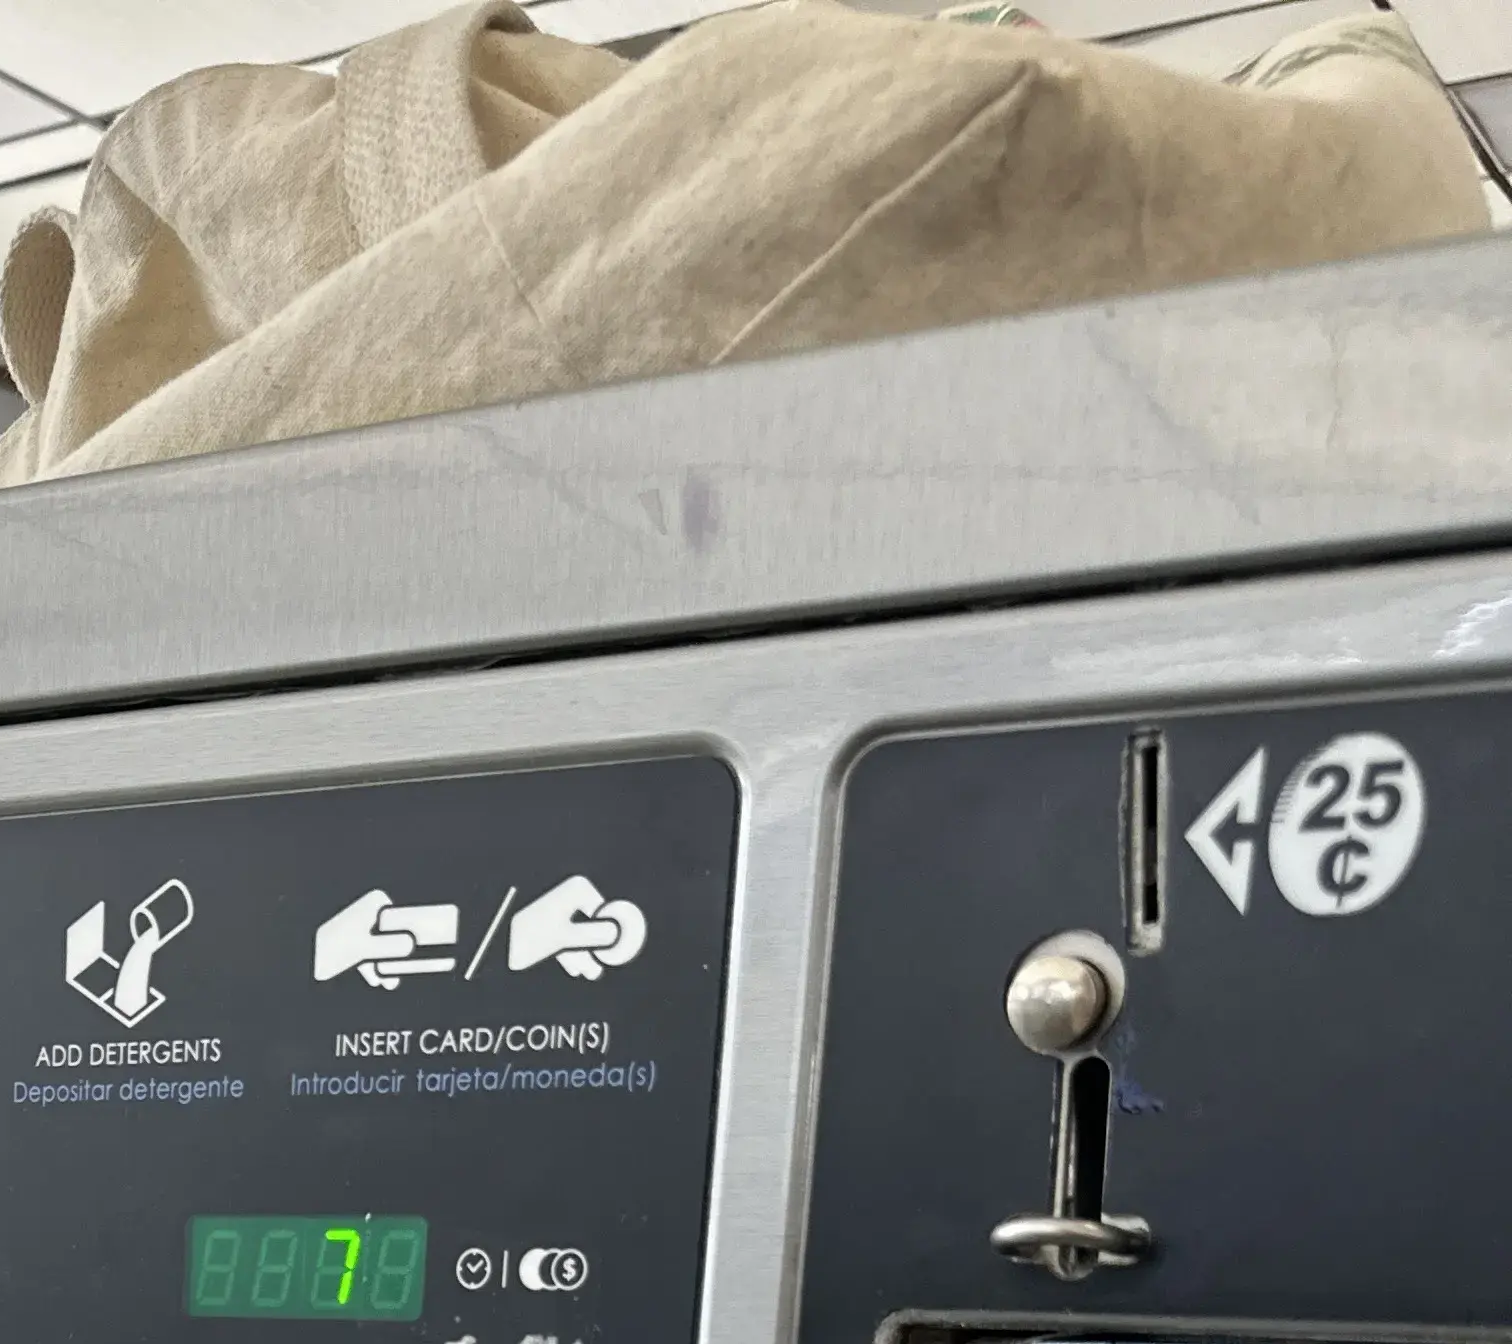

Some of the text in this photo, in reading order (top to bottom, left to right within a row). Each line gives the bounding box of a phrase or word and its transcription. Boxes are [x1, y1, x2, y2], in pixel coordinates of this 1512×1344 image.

[1298, 761, 1405, 832] 25
[1316, 837, 1371, 908] ¢
[36, 1039, 221, 1068] ADD DETERGENTS
[336, 1023, 610, 1057] INSERT CARD/COIN(S)
[13, 1076, 244, 1107] Depositar detergente
[290, 1061, 657, 1096] Introducir tarjeta/moneda(s)
[325, 1229, 361, 1304] 7
